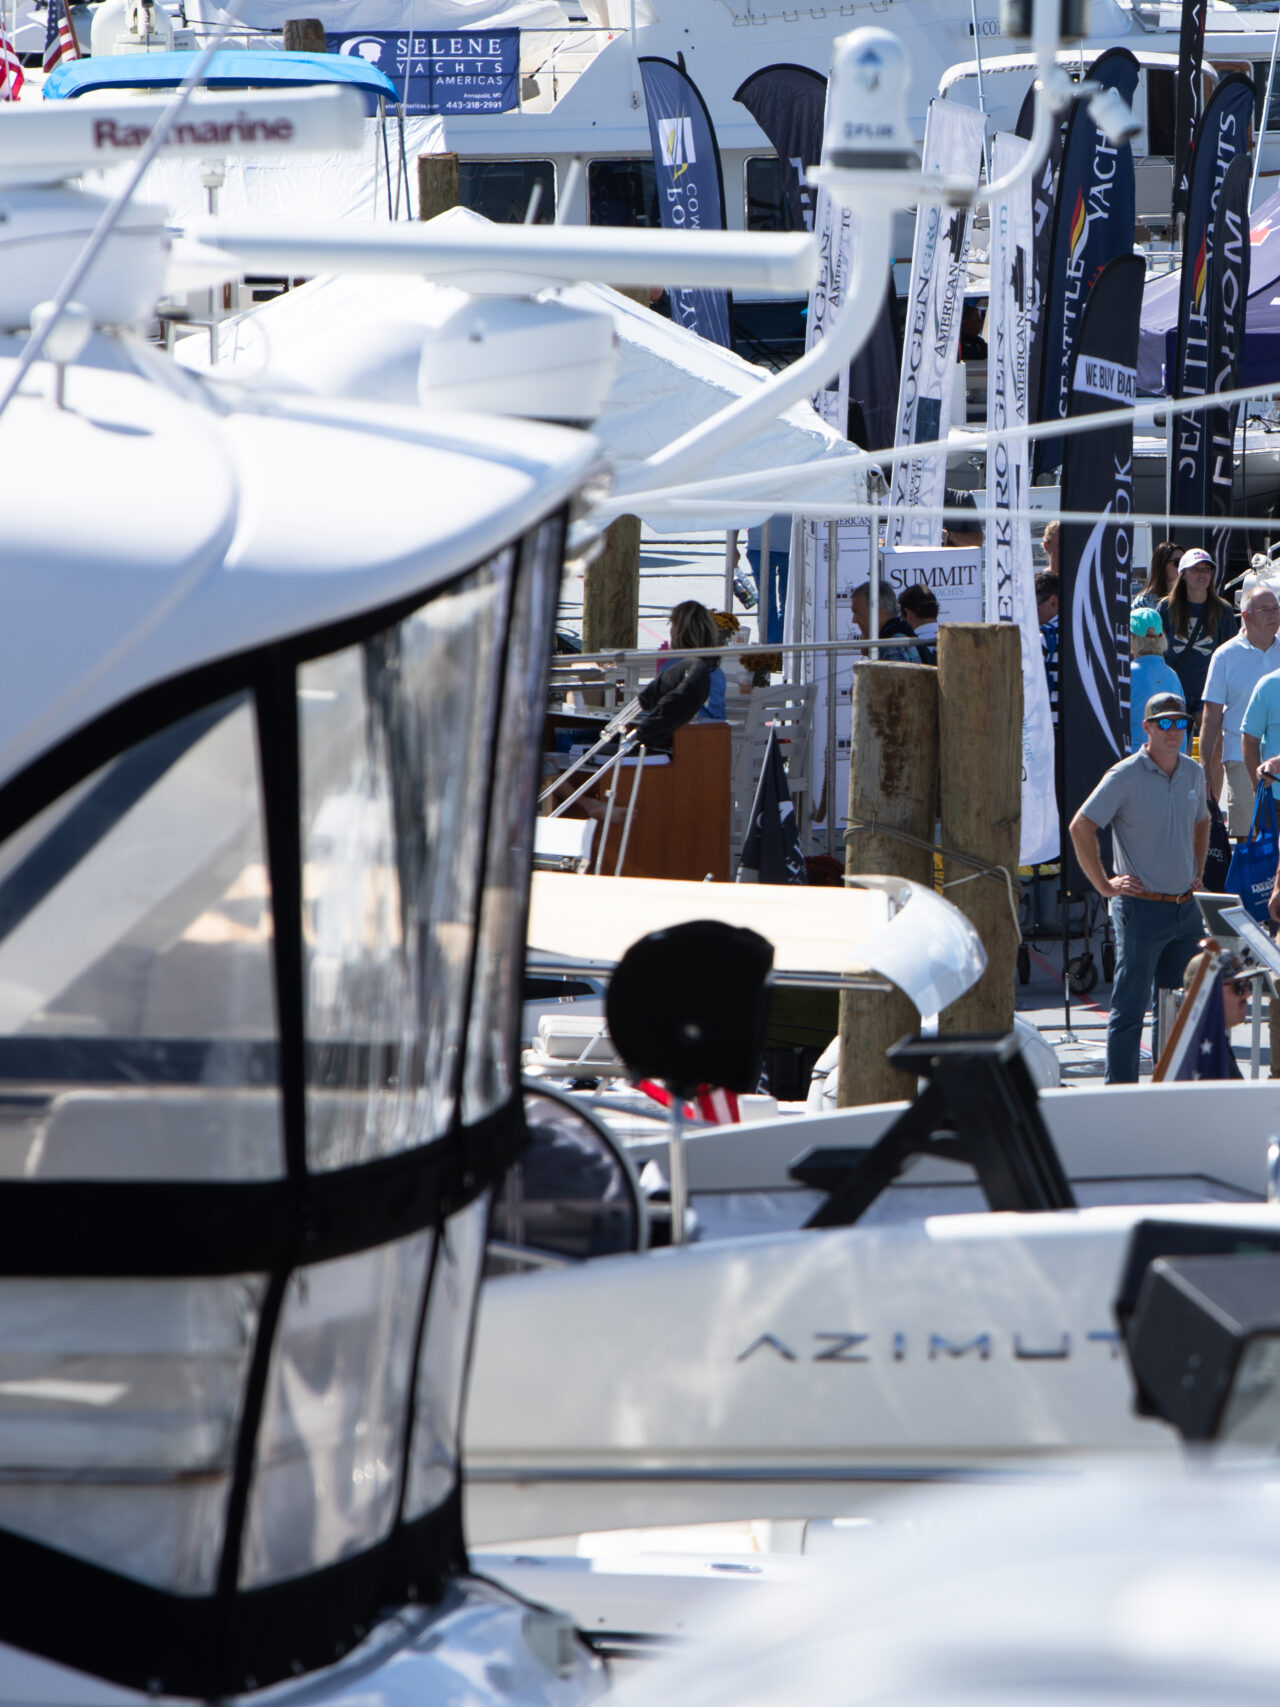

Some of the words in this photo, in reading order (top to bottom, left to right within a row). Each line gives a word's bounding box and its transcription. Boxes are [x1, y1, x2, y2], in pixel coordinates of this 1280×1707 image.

[397, 38, 502, 55] SELENE
[396, 62, 503, 73] YACHTS
[436, 76, 503, 85] AMERICAS
[934, 264, 959, 359] AMERICAN
[1015, 314, 1026, 420] AMERICAN
[1086, 362, 1098, 387] WE
[1099, 366, 1115, 391] BUY
[1115, 452, 1133, 603] HOOK
[890, 565, 977, 590] SUMMIT
[1115, 622, 1132, 719] THE
